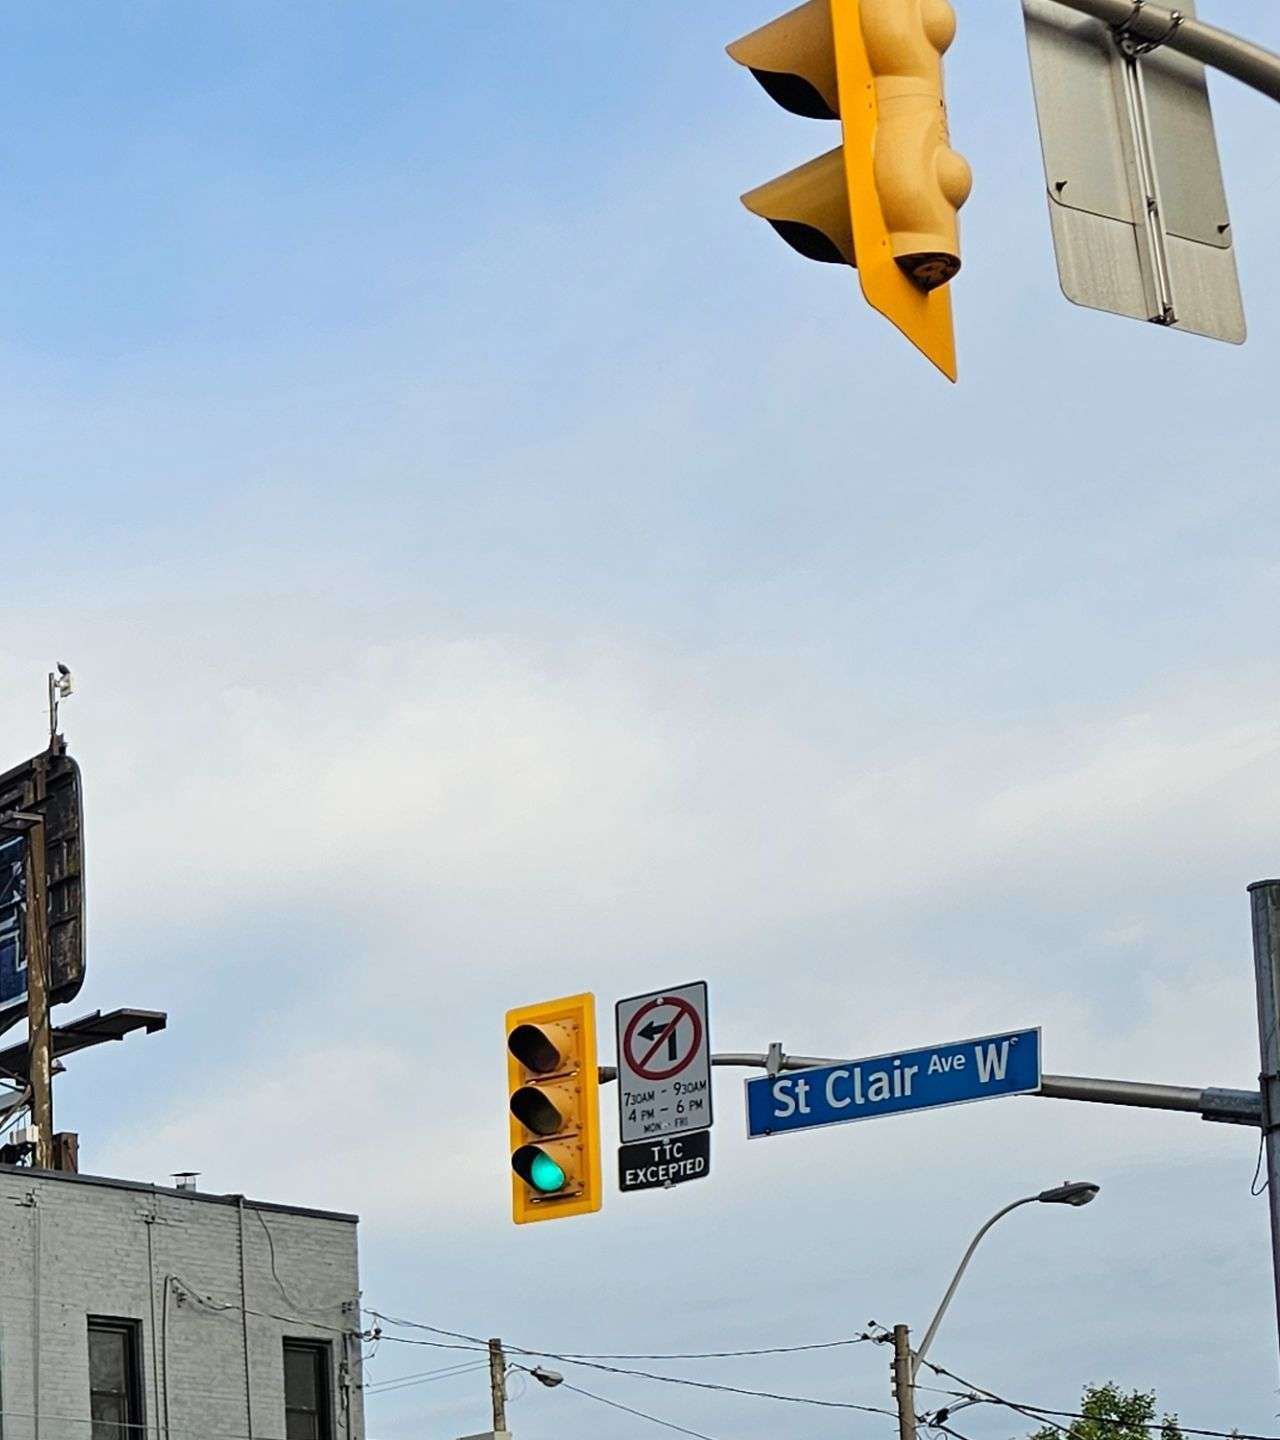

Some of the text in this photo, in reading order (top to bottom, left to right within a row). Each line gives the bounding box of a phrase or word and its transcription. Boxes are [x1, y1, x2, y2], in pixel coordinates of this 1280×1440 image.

[772, 1040, 1011, 1117] St Clair Ave W
[651, 1142, 683, 1161] TTC
[625, 1157, 705, 1186] EXCEPTED
